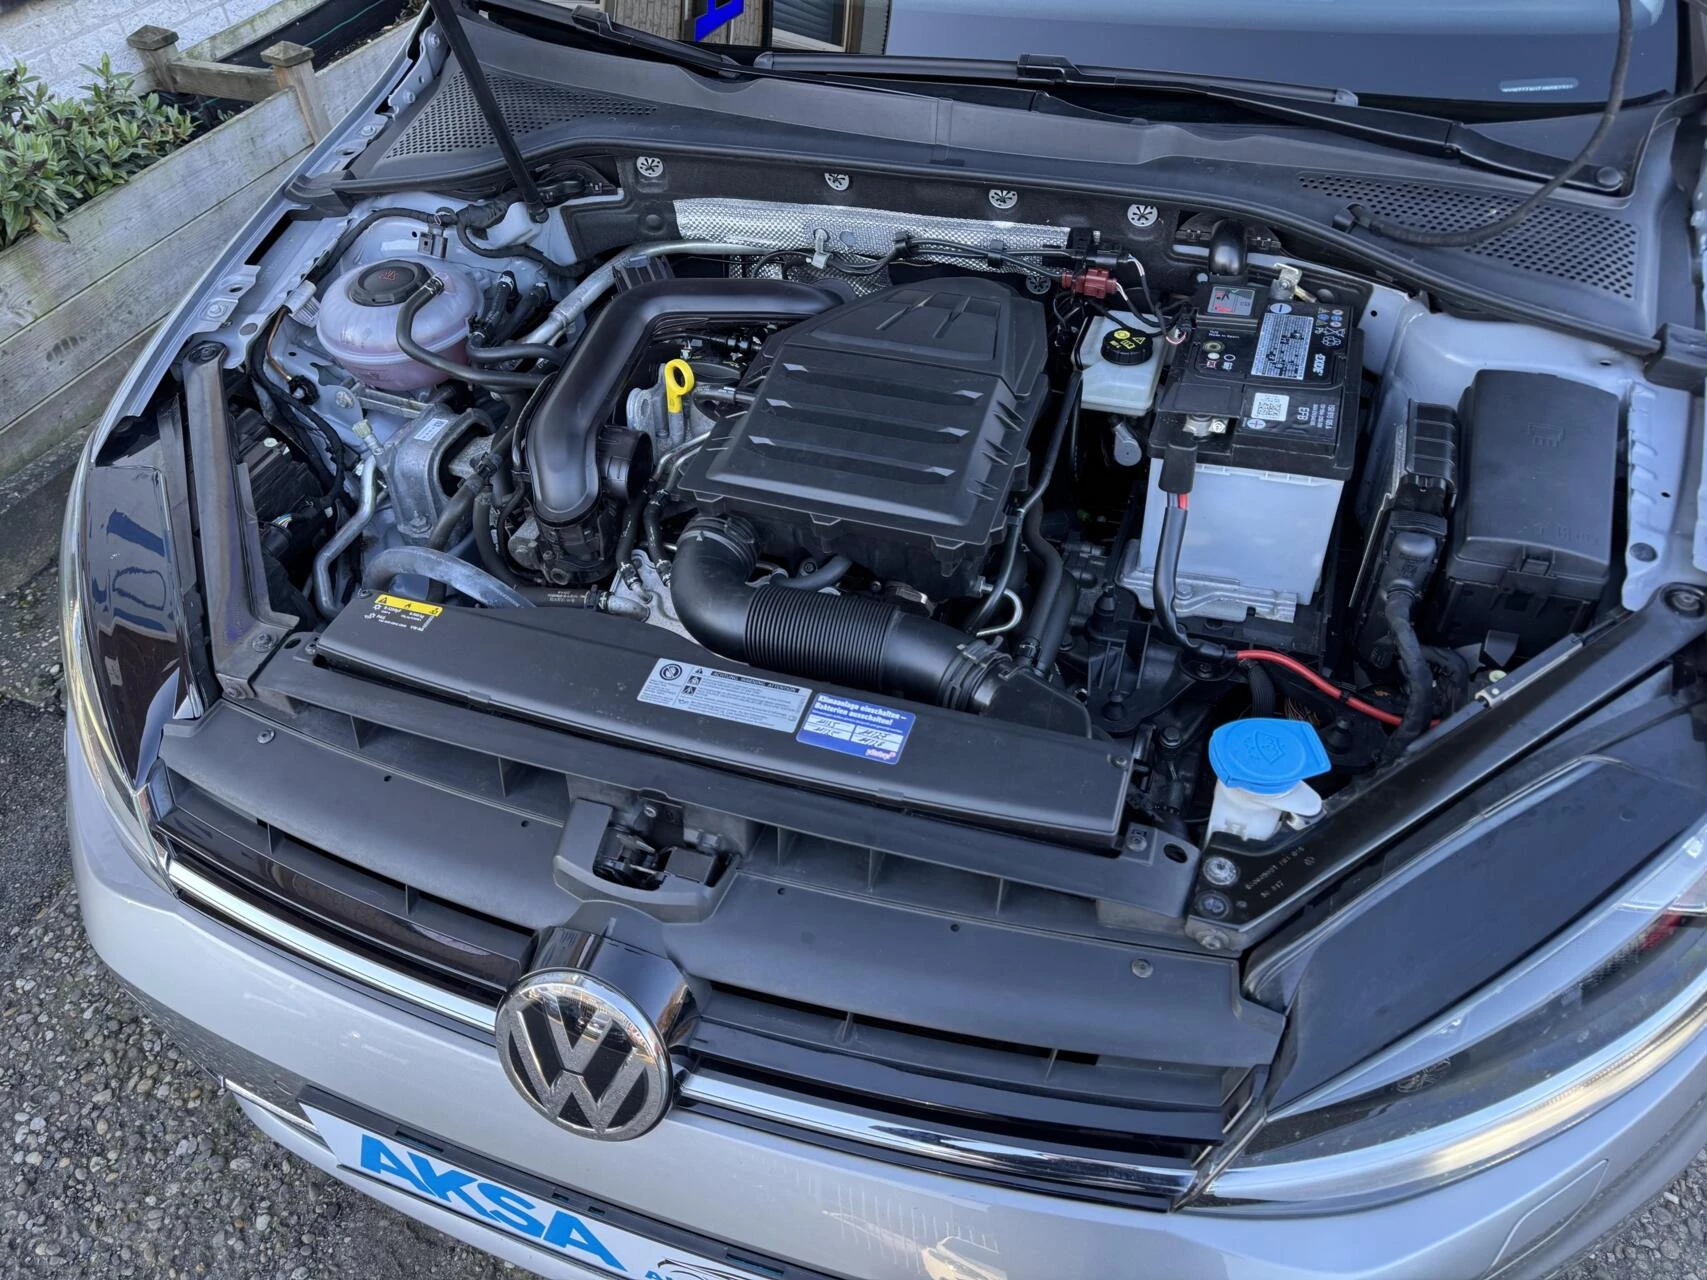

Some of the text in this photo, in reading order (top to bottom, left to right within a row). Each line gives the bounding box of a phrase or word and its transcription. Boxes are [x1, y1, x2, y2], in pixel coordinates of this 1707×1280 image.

[1297, 406, 1310, 420] EFB
[500, 992, 659, 1136] VW
[360, 1134, 628, 1272] AKSA
